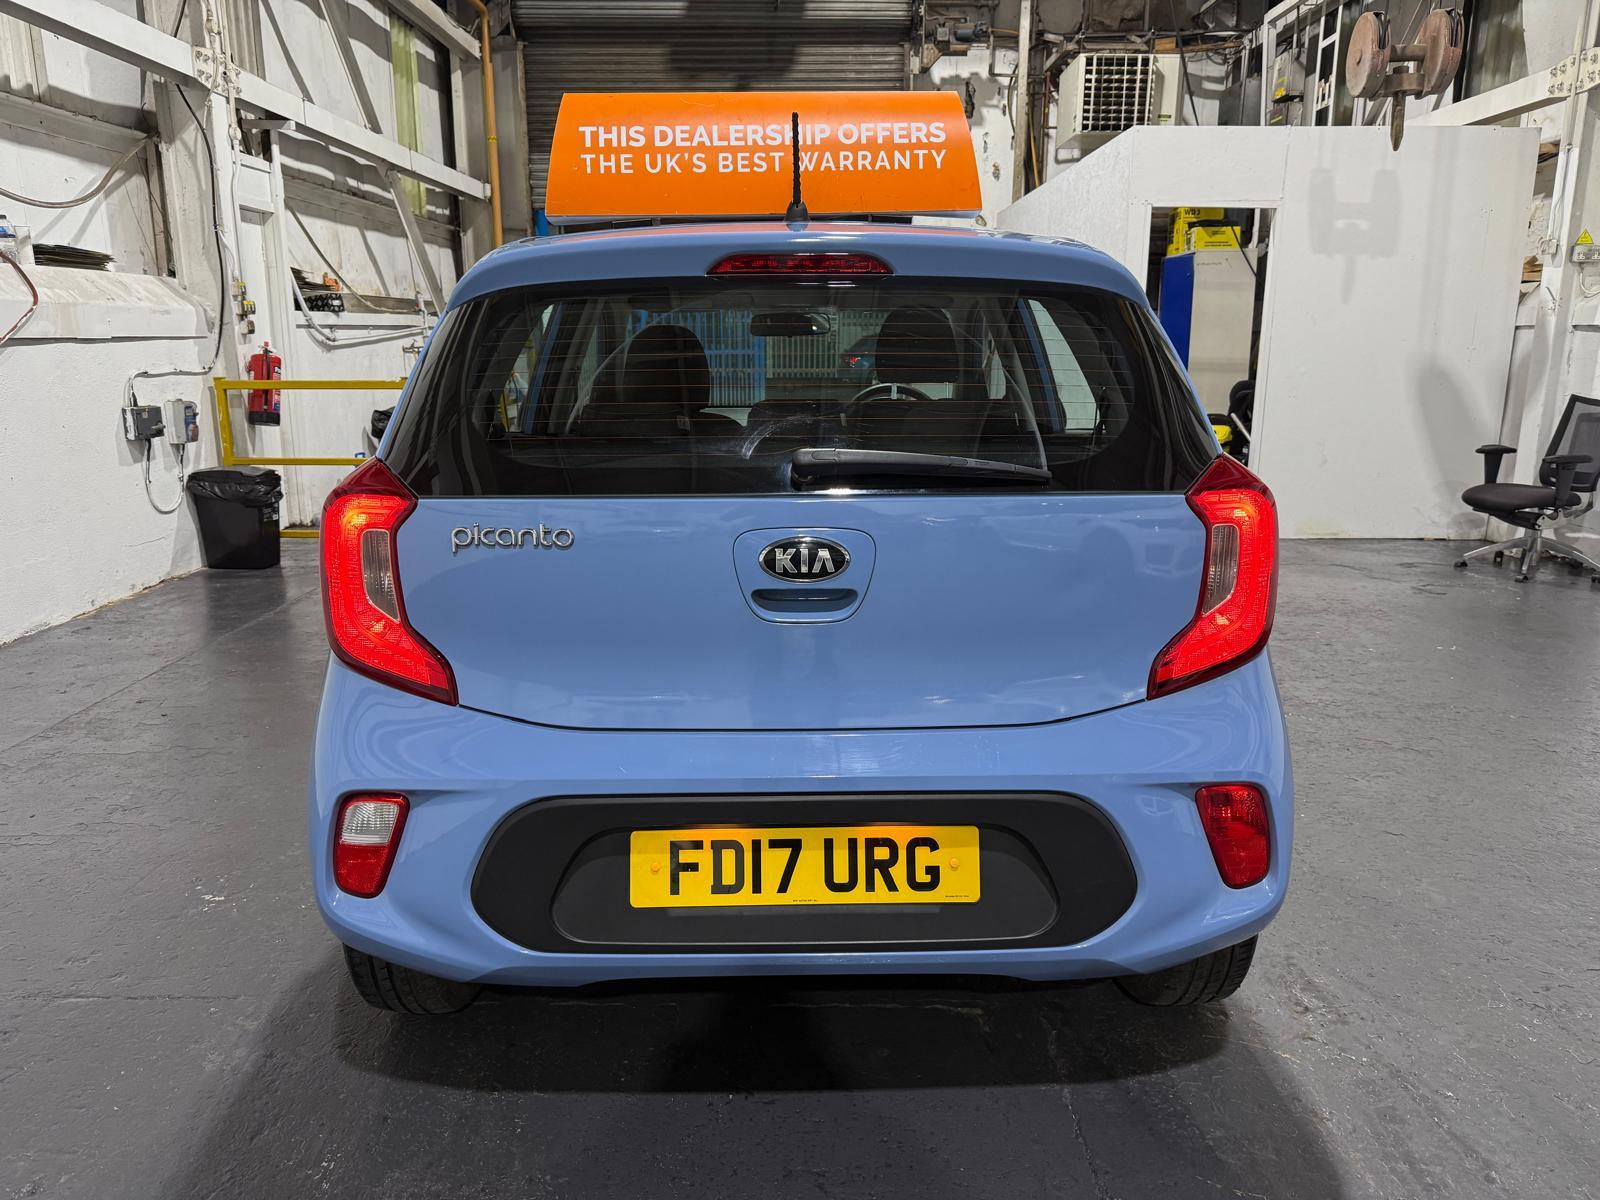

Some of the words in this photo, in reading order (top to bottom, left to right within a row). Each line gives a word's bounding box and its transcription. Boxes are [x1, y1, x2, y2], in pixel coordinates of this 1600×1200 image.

[579, 126, 646, 148] THIS
[654, 123, 831, 147] DEALERSHIP
[837, 122, 947, 144] OFFERS
[581, 154, 634, 174] THE
[645, 152, 707, 174] UK'S
[719, 151, 785, 173] BEST
[797, 149, 947, 172] WARRANTY
[451, 522, 574, 554] picanto
[774, 548, 836, 573] KIA
[669, 838, 803, 896] FD17
[823, 837, 941, 893] URG
